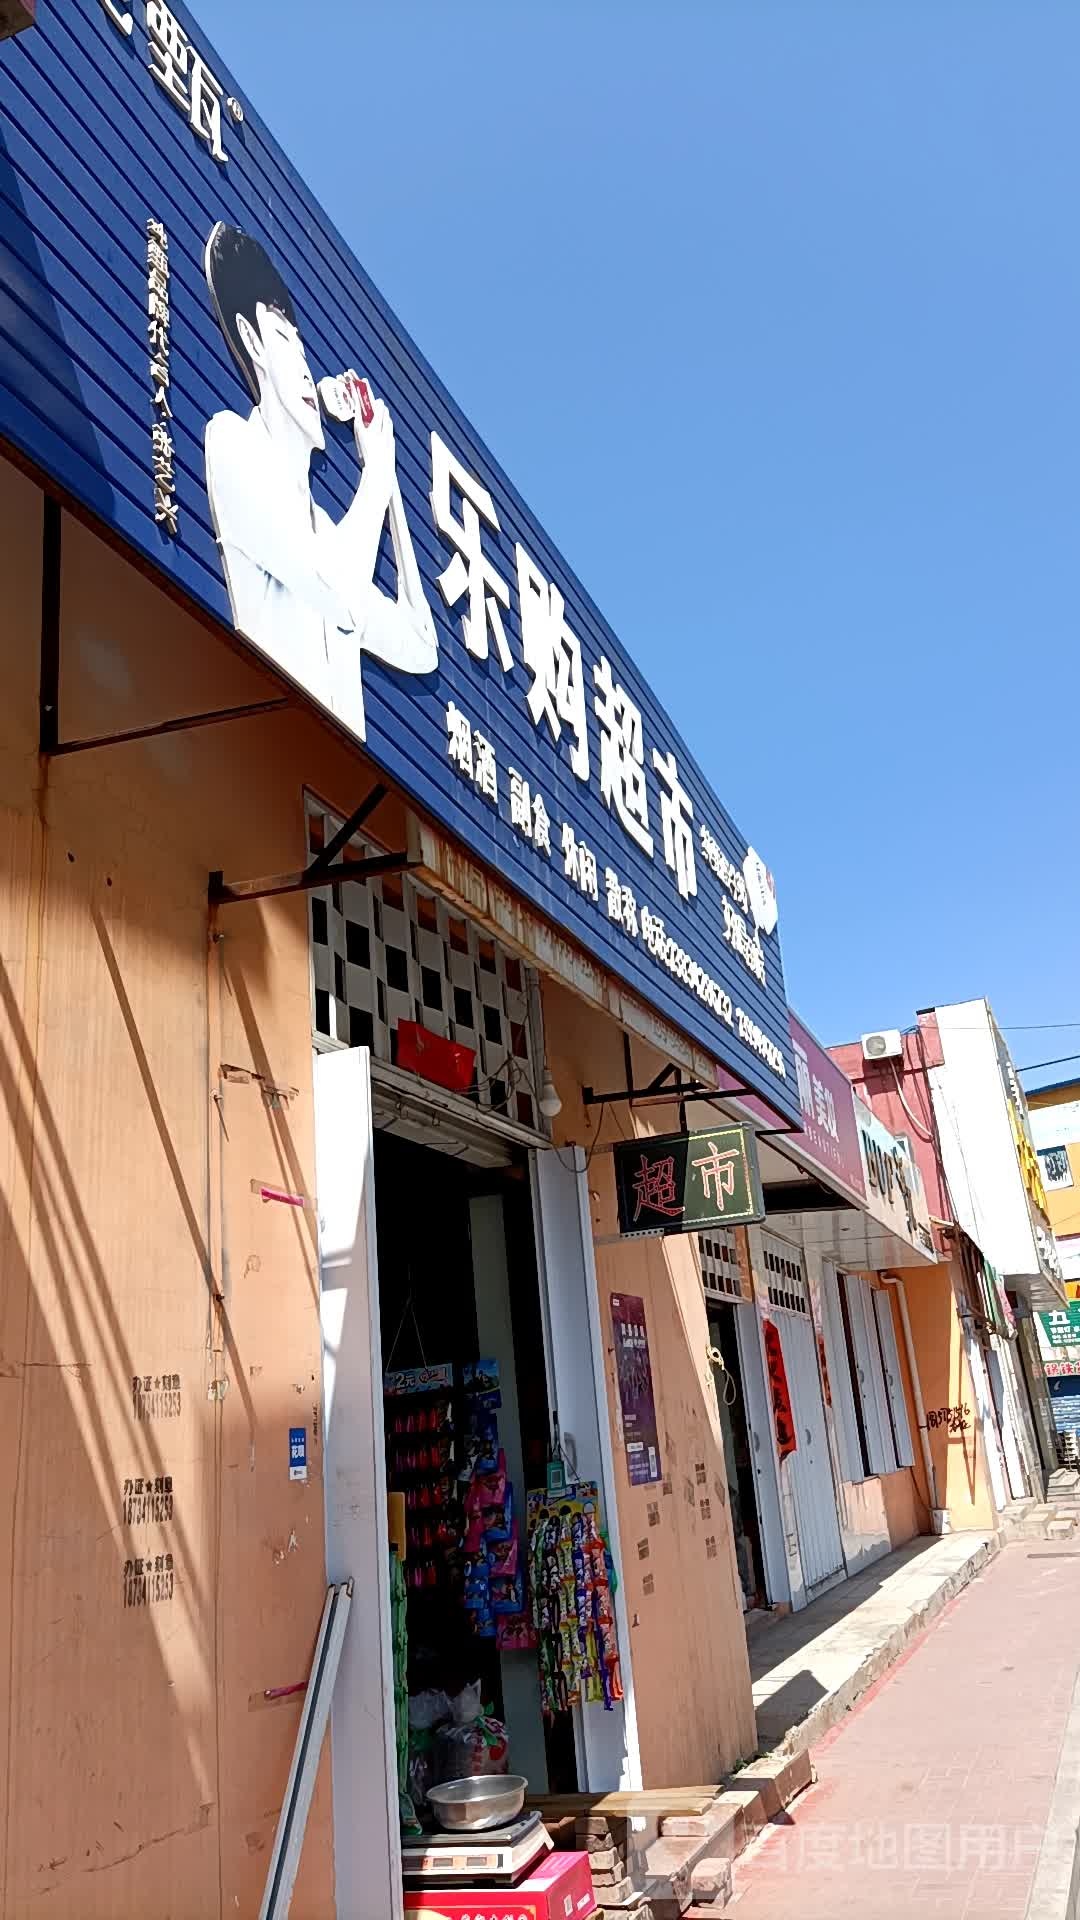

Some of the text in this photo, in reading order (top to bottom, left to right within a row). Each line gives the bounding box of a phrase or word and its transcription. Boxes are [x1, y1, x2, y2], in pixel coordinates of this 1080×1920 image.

[430, 430, 698, 900] 乐购超市
[446, 701, 498, 803] 烟酒
[509, 766, 551, 857] 副食
[561, 822, 599, 901] 休闲
[632, 1141, 740, 1223] 超市
